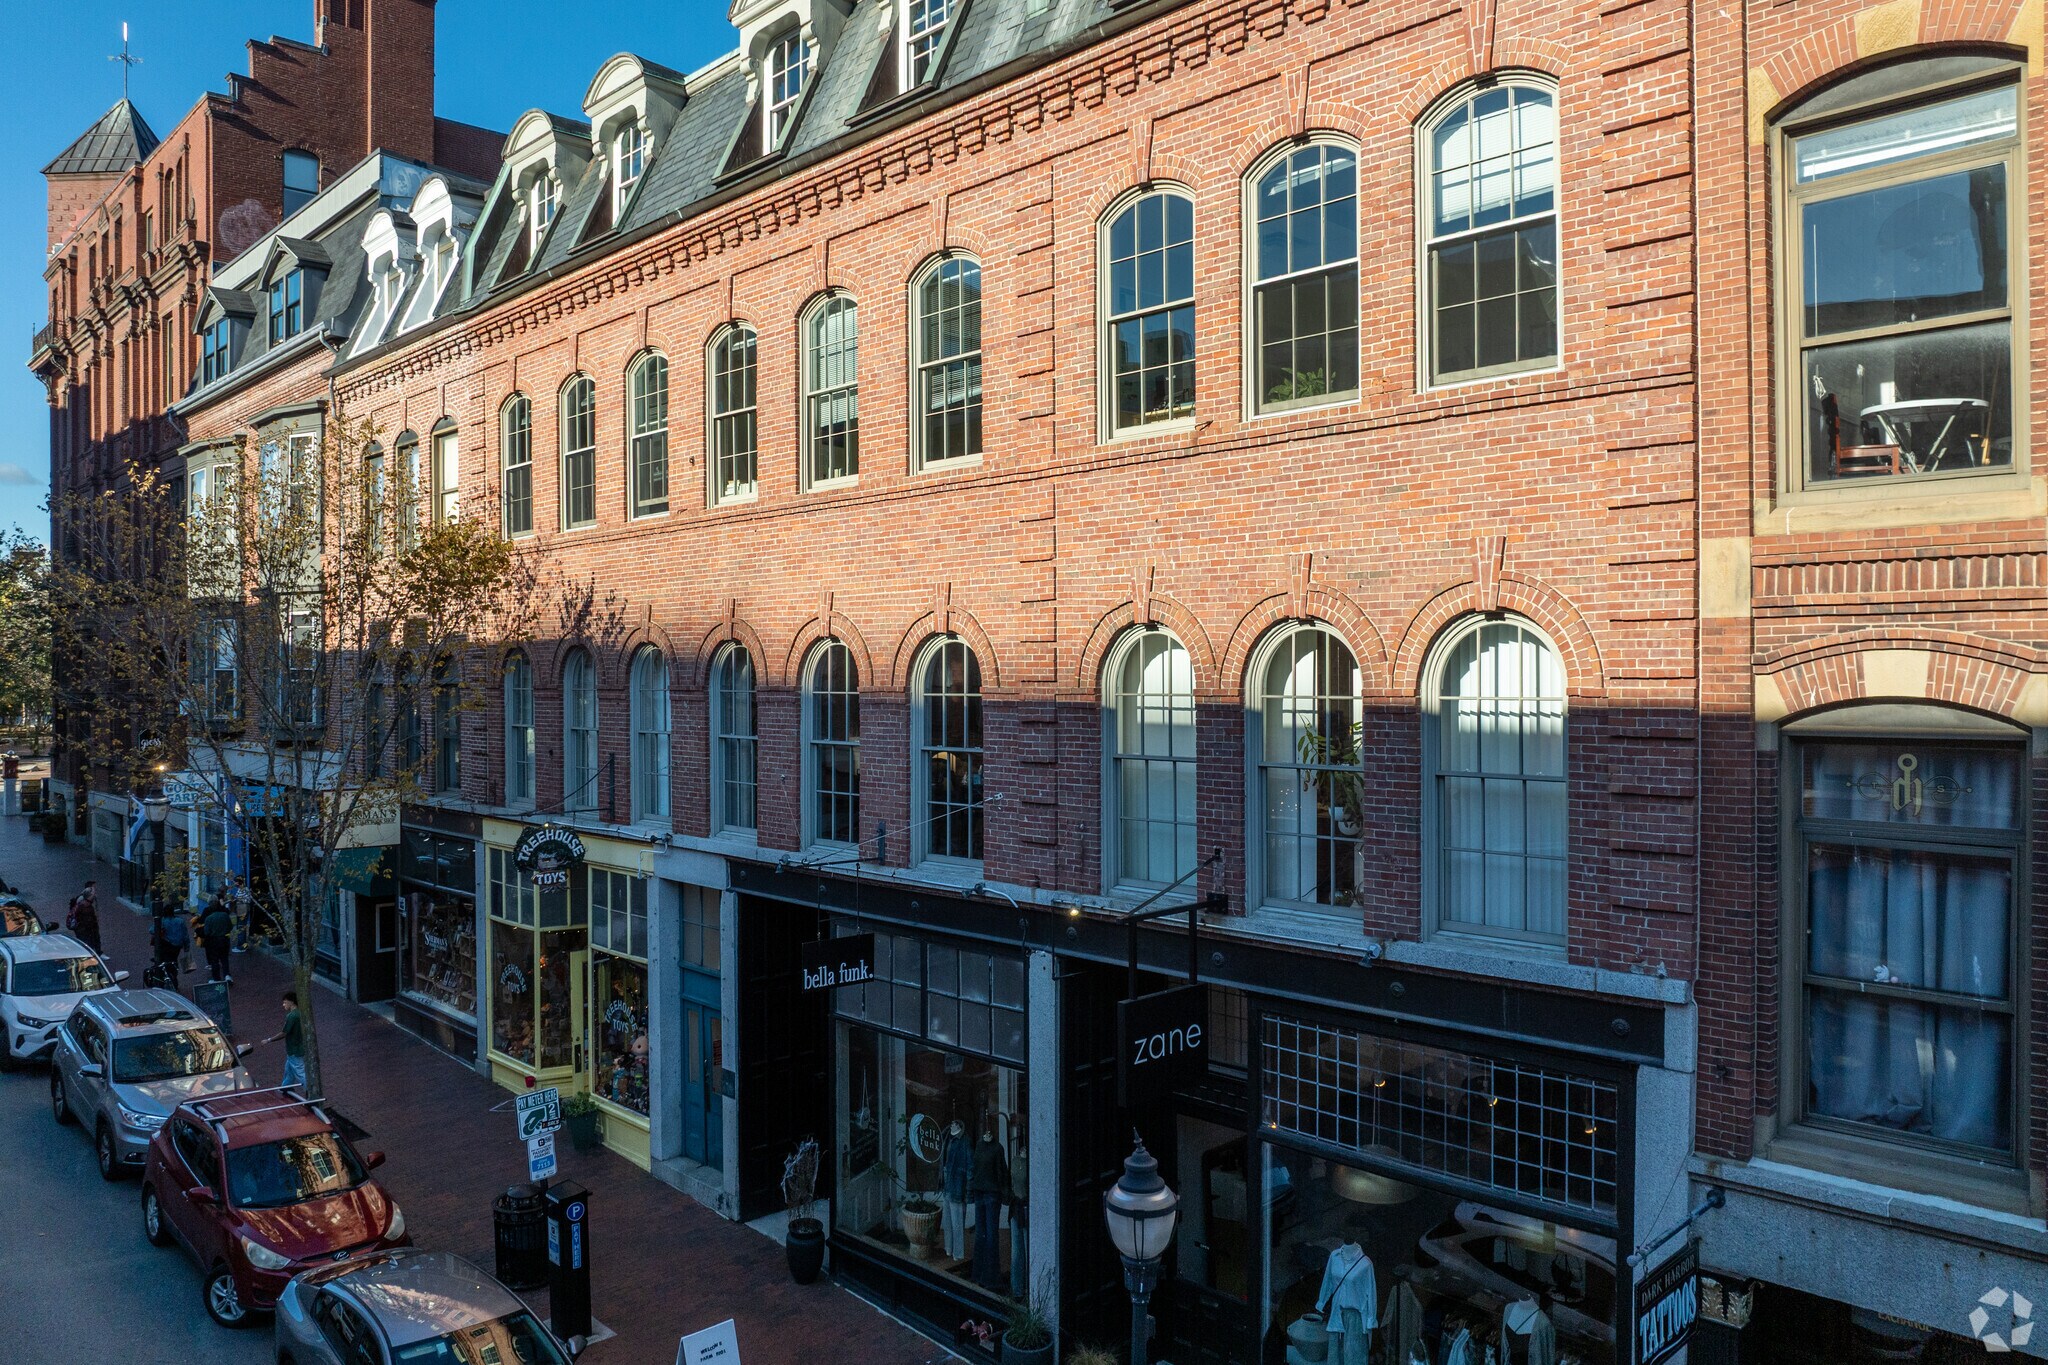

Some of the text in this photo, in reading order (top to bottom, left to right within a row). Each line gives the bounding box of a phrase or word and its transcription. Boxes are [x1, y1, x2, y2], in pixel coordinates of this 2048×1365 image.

[517, 829, 584, 861] TREEHOUSE
[537, 871, 566, 885] TOYS
[501, 963, 527, 993] TREEHOUSE
[803, 959, 874, 990] bella funk.
[507, 982, 520, 994] TOYS
[604, 1000, 638, 1031] TREEHOUSE
[613, 1019, 629, 1033] TOYS
[1134, 1024, 1201, 1065] zane
[518, 1089, 557, 1111] PAY METER HERE
[549, 1104, 556, 1113] 2
[920, 1126, 940, 1141] bella
[920, 1136, 940, 1151] funk
[572, 1206, 580, 1218] P
[1642, 1254, 1696, 1308] DARK HARBOR
[1640, 1274, 1697, 1364] TATTOOS
[700, 1341, 722, 1355] WELCOME
